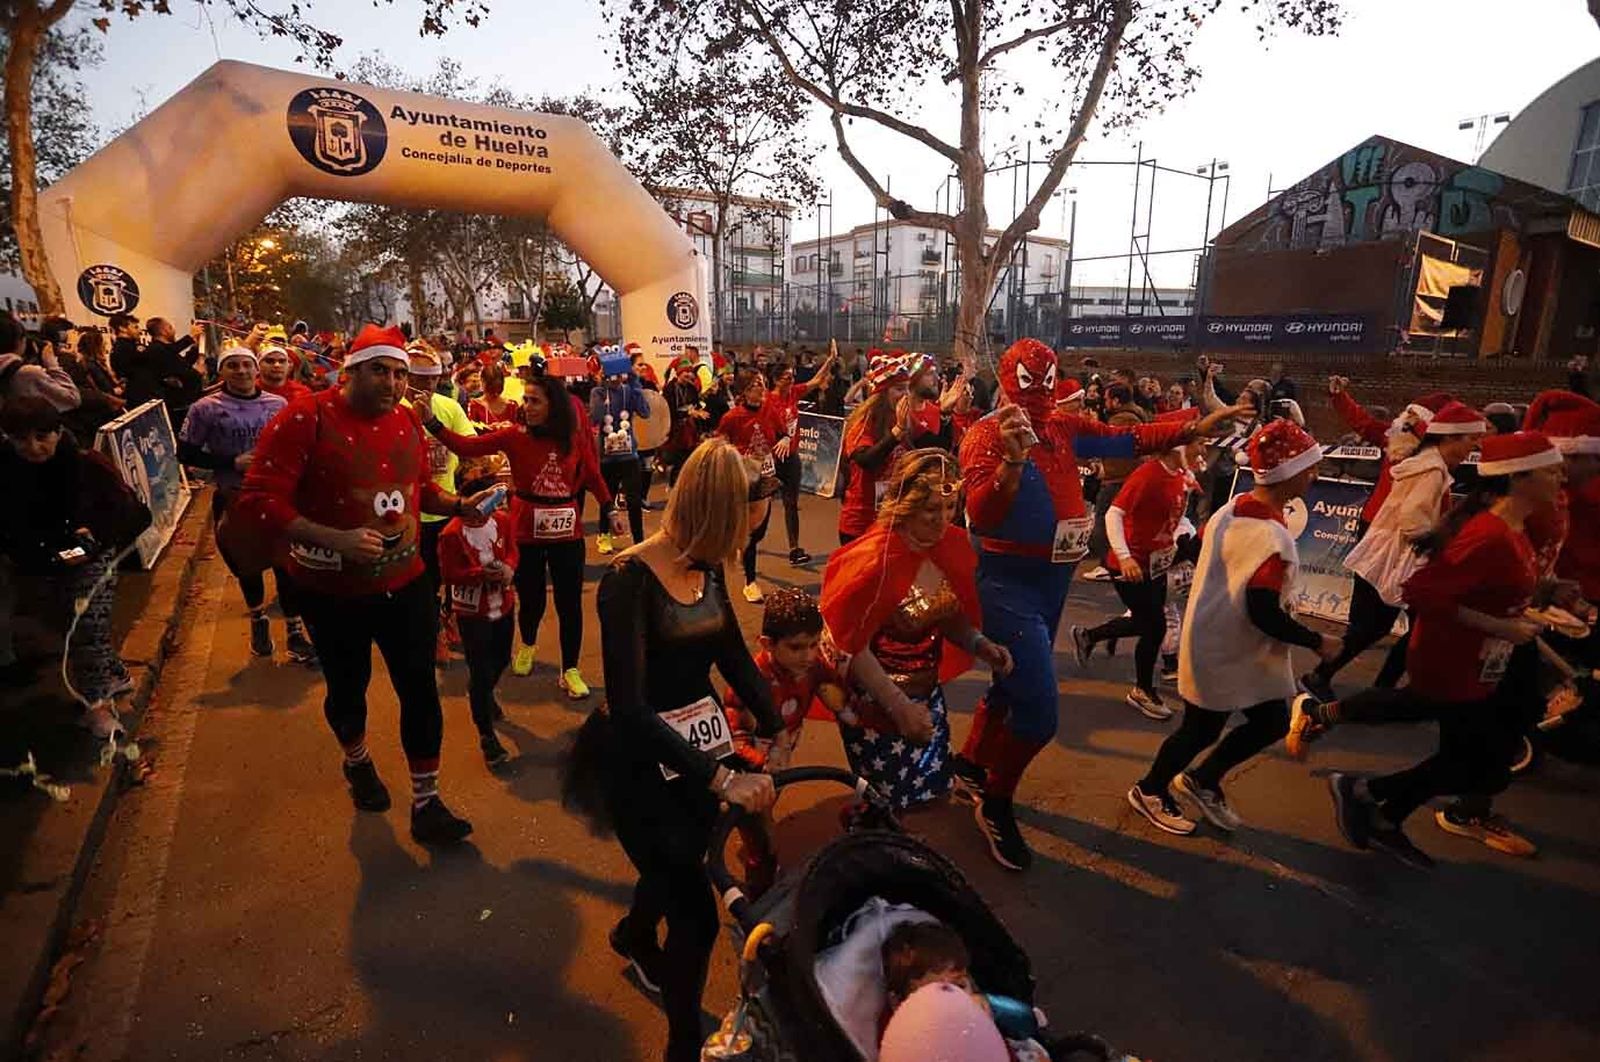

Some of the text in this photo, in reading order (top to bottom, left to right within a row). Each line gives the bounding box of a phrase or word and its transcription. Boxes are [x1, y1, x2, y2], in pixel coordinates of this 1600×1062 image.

[390, 105, 548, 139] Ayuntamiento
[439, 131, 550, 159] de Huelva
[476, 157, 492, 168] de
[495, 158, 552, 174] Deportes
[1085, 324, 1186, 333] HYUNDAI HYUNDAI
[1225, 322, 1363, 332] HYUNDAI HYUNDAI
[799, 427, 820, 439] ento
[552, 517, 572, 530] 475
[689, 715, 722, 749] 490
